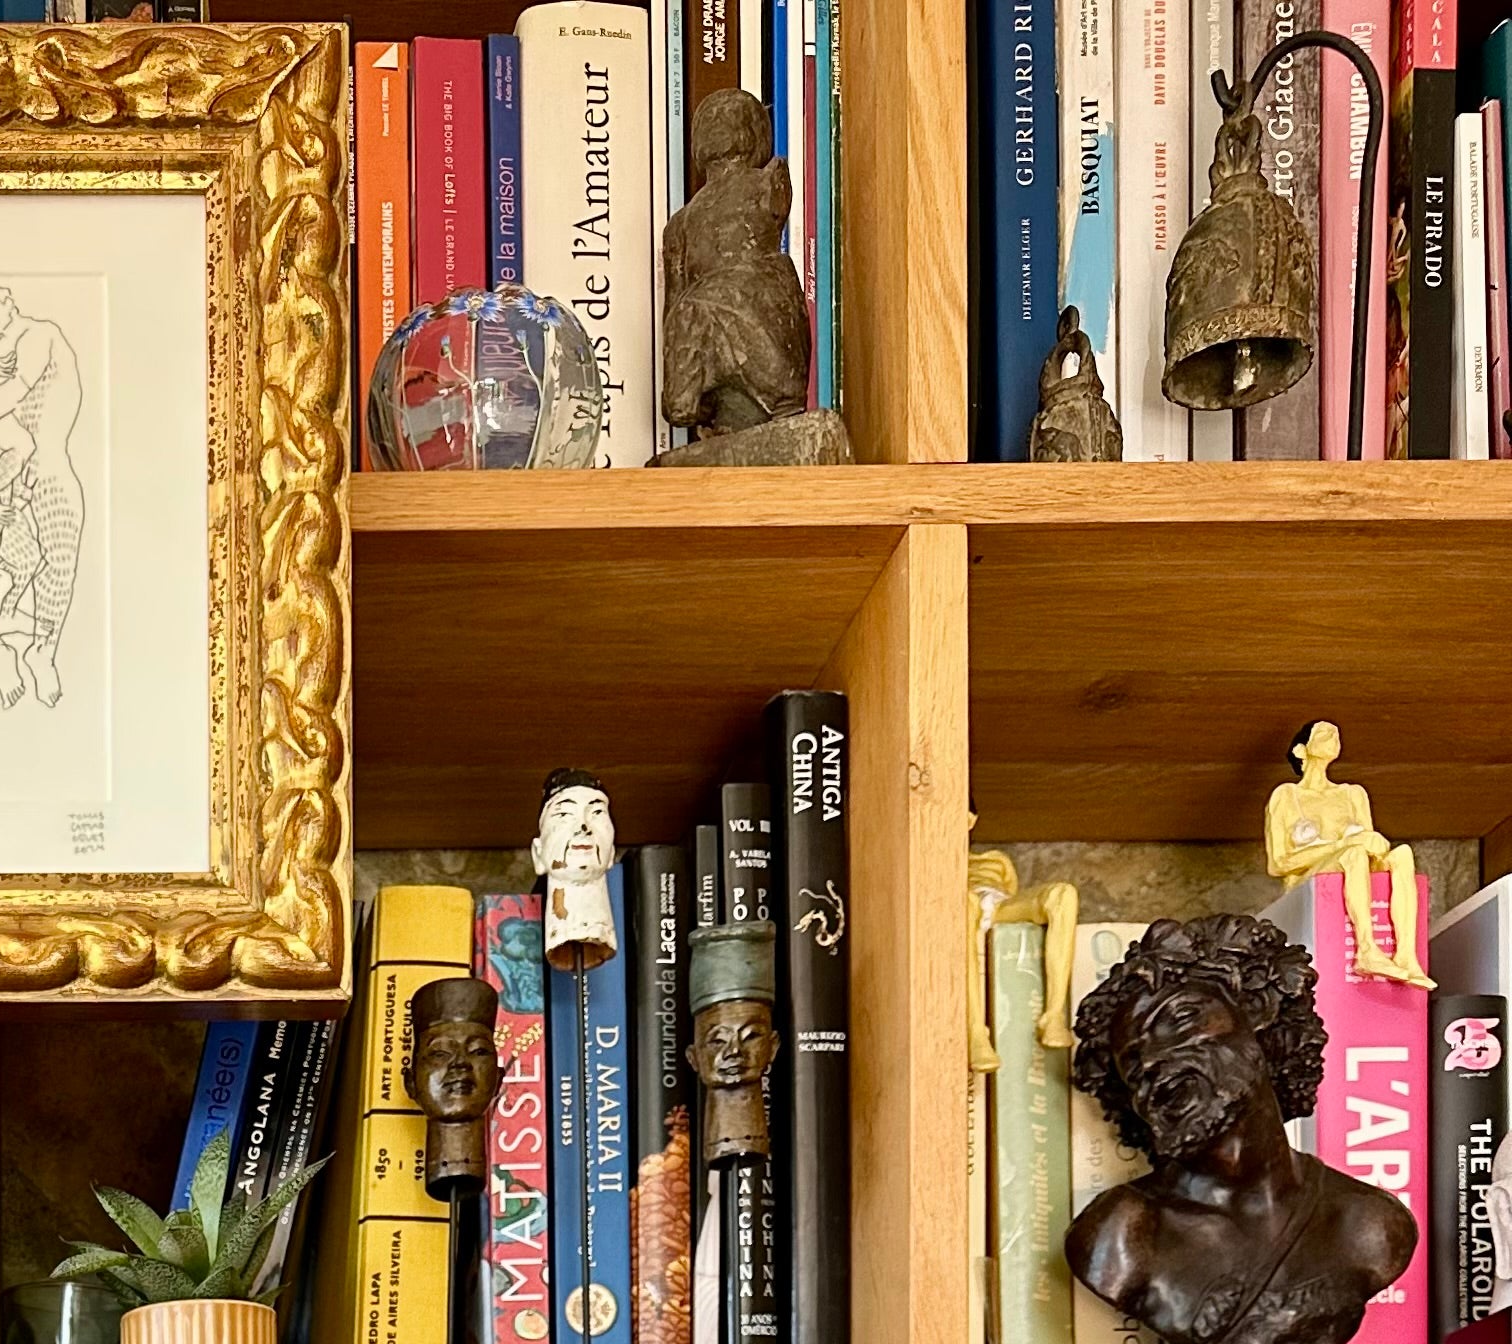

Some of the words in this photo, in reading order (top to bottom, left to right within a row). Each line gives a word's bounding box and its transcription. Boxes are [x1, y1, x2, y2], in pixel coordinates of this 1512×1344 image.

[1014, 42, 1035, 187] GERHARD
[570, 61, 610, 262] l'Amateur
[1080, 95, 1103, 216] BASQUIAT
[1153, 140, 1167, 185] L'ŒUVRE
[499, 156, 516, 230] maison
[1424, 175, 1445, 204] LE
[380, 201, 395, 297] CONTEMPORAINS
[497, 235, 516, 260] la
[1020, 217, 1032, 258] ELGER
[1154, 202, 1168, 252] PICASSO
[1424, 208, 1445, 289] PRADO
[572, 267, 610, 322] de
[1021, 260, 1033, 320] DIETMAR
[382, 298, 395, 345] TISTES
[791, 730, 819, 817] CHINA
[820, 722, 842, 824] ANTIGA
[654, 917, 677, 966] Laca
[654, 967, 678, 994] da
[383, 972, 398, 1067] PORTUGUESA
[594, 1025, 620, 1059] D.
[654, 997, 678, 1070] mundo
[381, 1071, 392, 1102] ARTE
[662, 1073, 678, 1089] o
[595, 1064, 623, 1162] MARIA
[374, 1147, 389, 1181] 1850
[413, 1148, 424, 1182] 1910
[1469, 1117, 1493, 1175] THE
[496, 1051, 544, 1303] MATISSE
[597, 1171, 623, 1194] II
[389, 1229, 403, 1292] SILVEIRA
[370, 1270, 383, 1306] LAPA
[387, 1295, 398, 1330] AIRES
